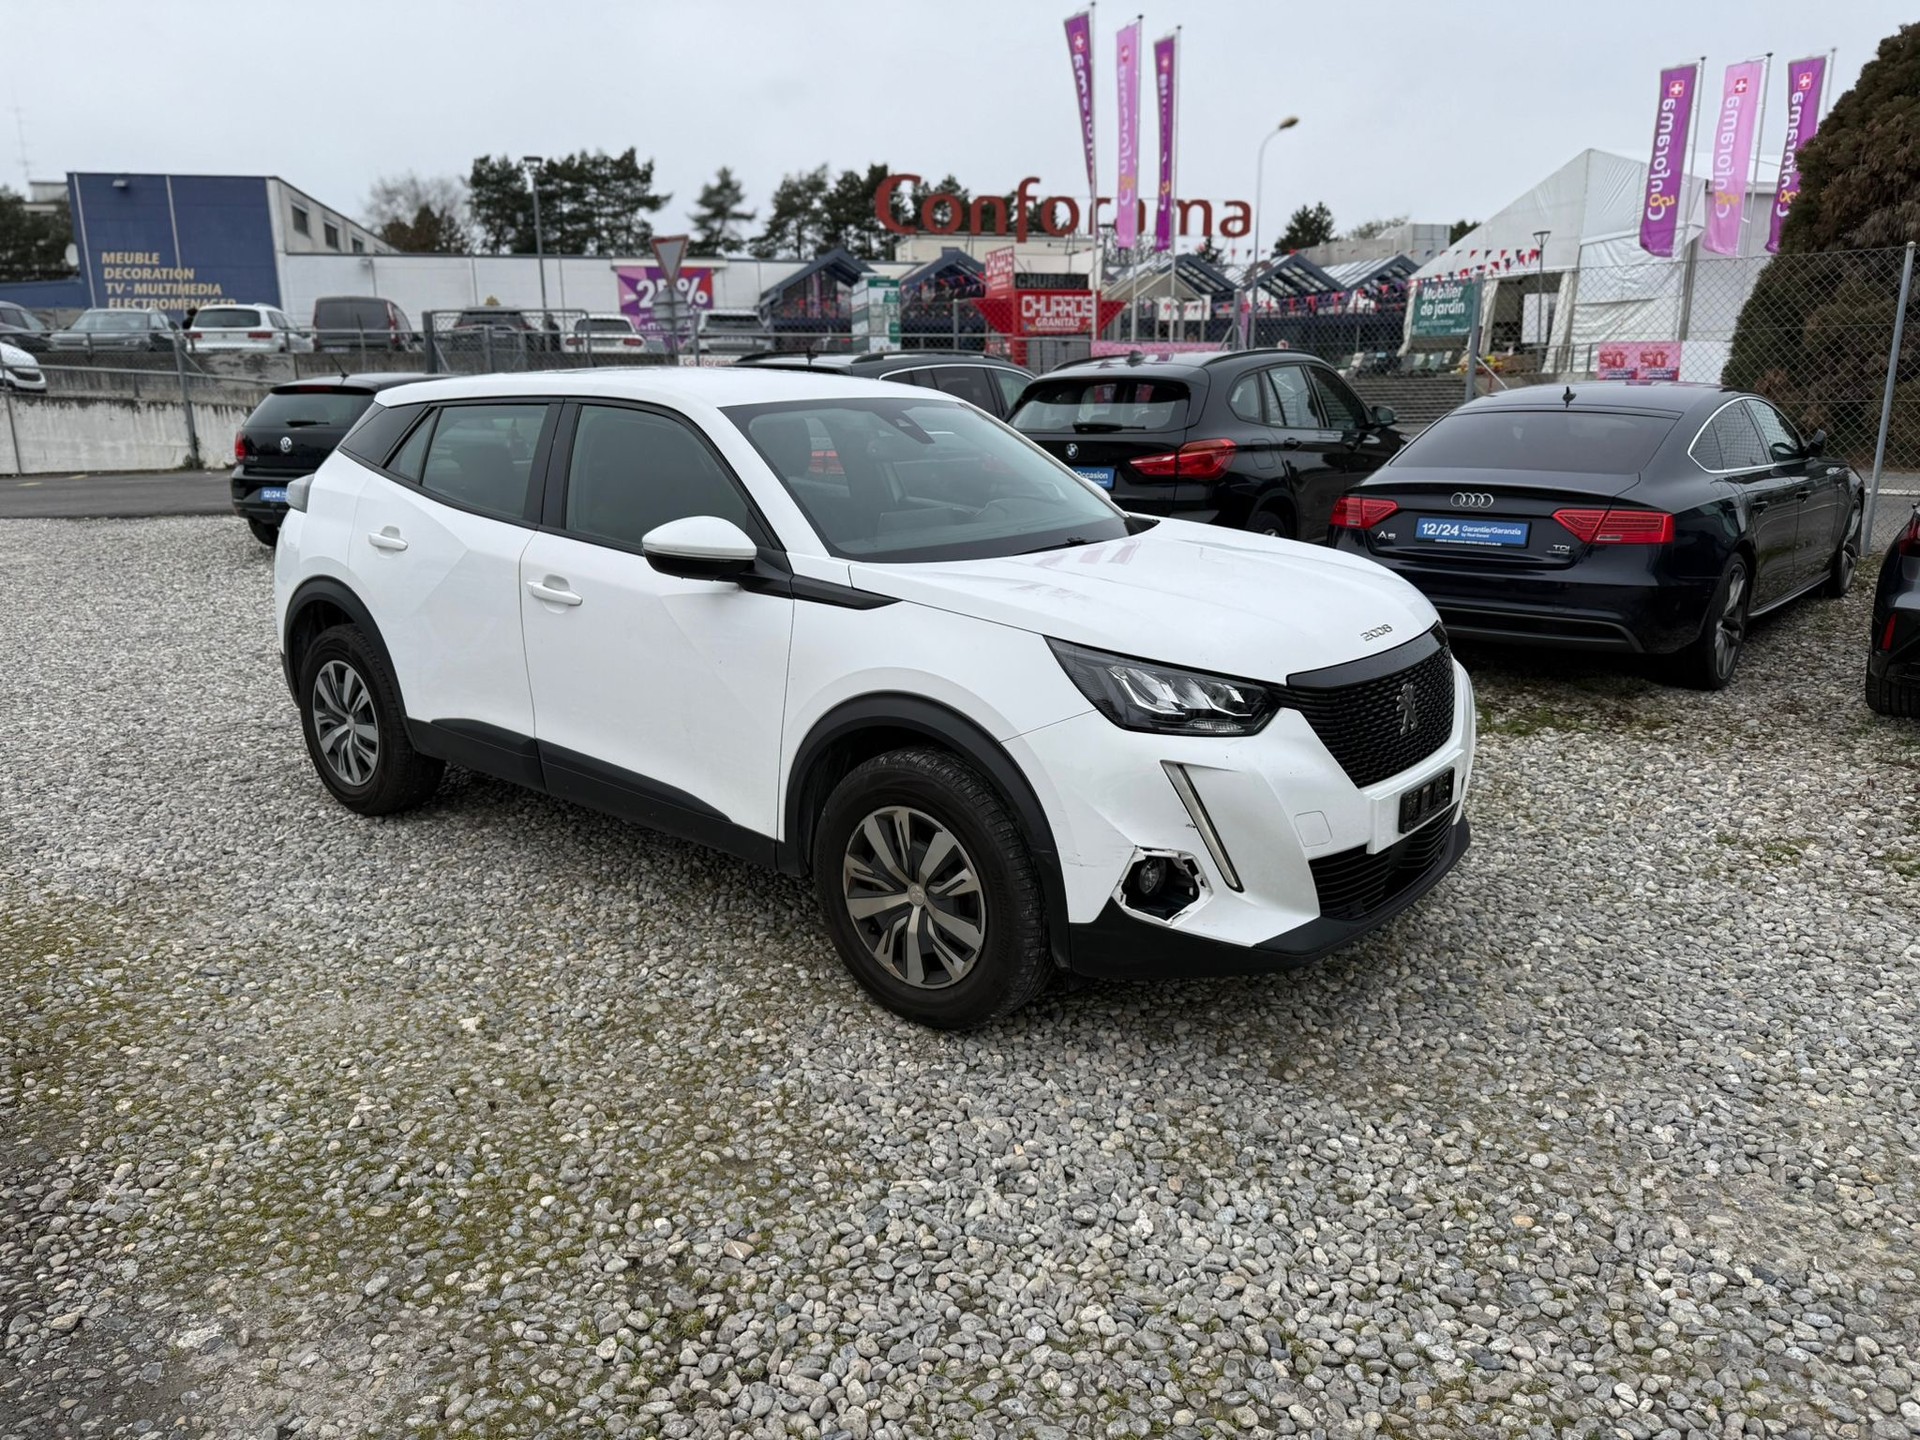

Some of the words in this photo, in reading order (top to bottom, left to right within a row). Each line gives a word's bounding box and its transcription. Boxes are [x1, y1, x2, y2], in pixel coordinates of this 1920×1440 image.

[101, 252, 160, 264] MEUBLE
[104, 268, 195, 280] DECORATION
[134, 283, 222, 296] MULTIMEDIA
[1423, 283, 1463, 300] Mobilier
[1022, 295, 1093, 318] CHURROS
[1420, 302, 1433, 316] de
[1433, 299, 1465, 320] jardin
[1035, 317, 1080, 328] GRANITAS
[264, 490, 280, 499] 12/24
[1377, 530, 1396, 540] A5
[1421, 523, 1460, 537] 12/24
[1462, 525, 1522, 536] Garantie/Garanzia
[1553, 544, 1571, 553] TDI
[1360, 624, 1393, 642] 2008
